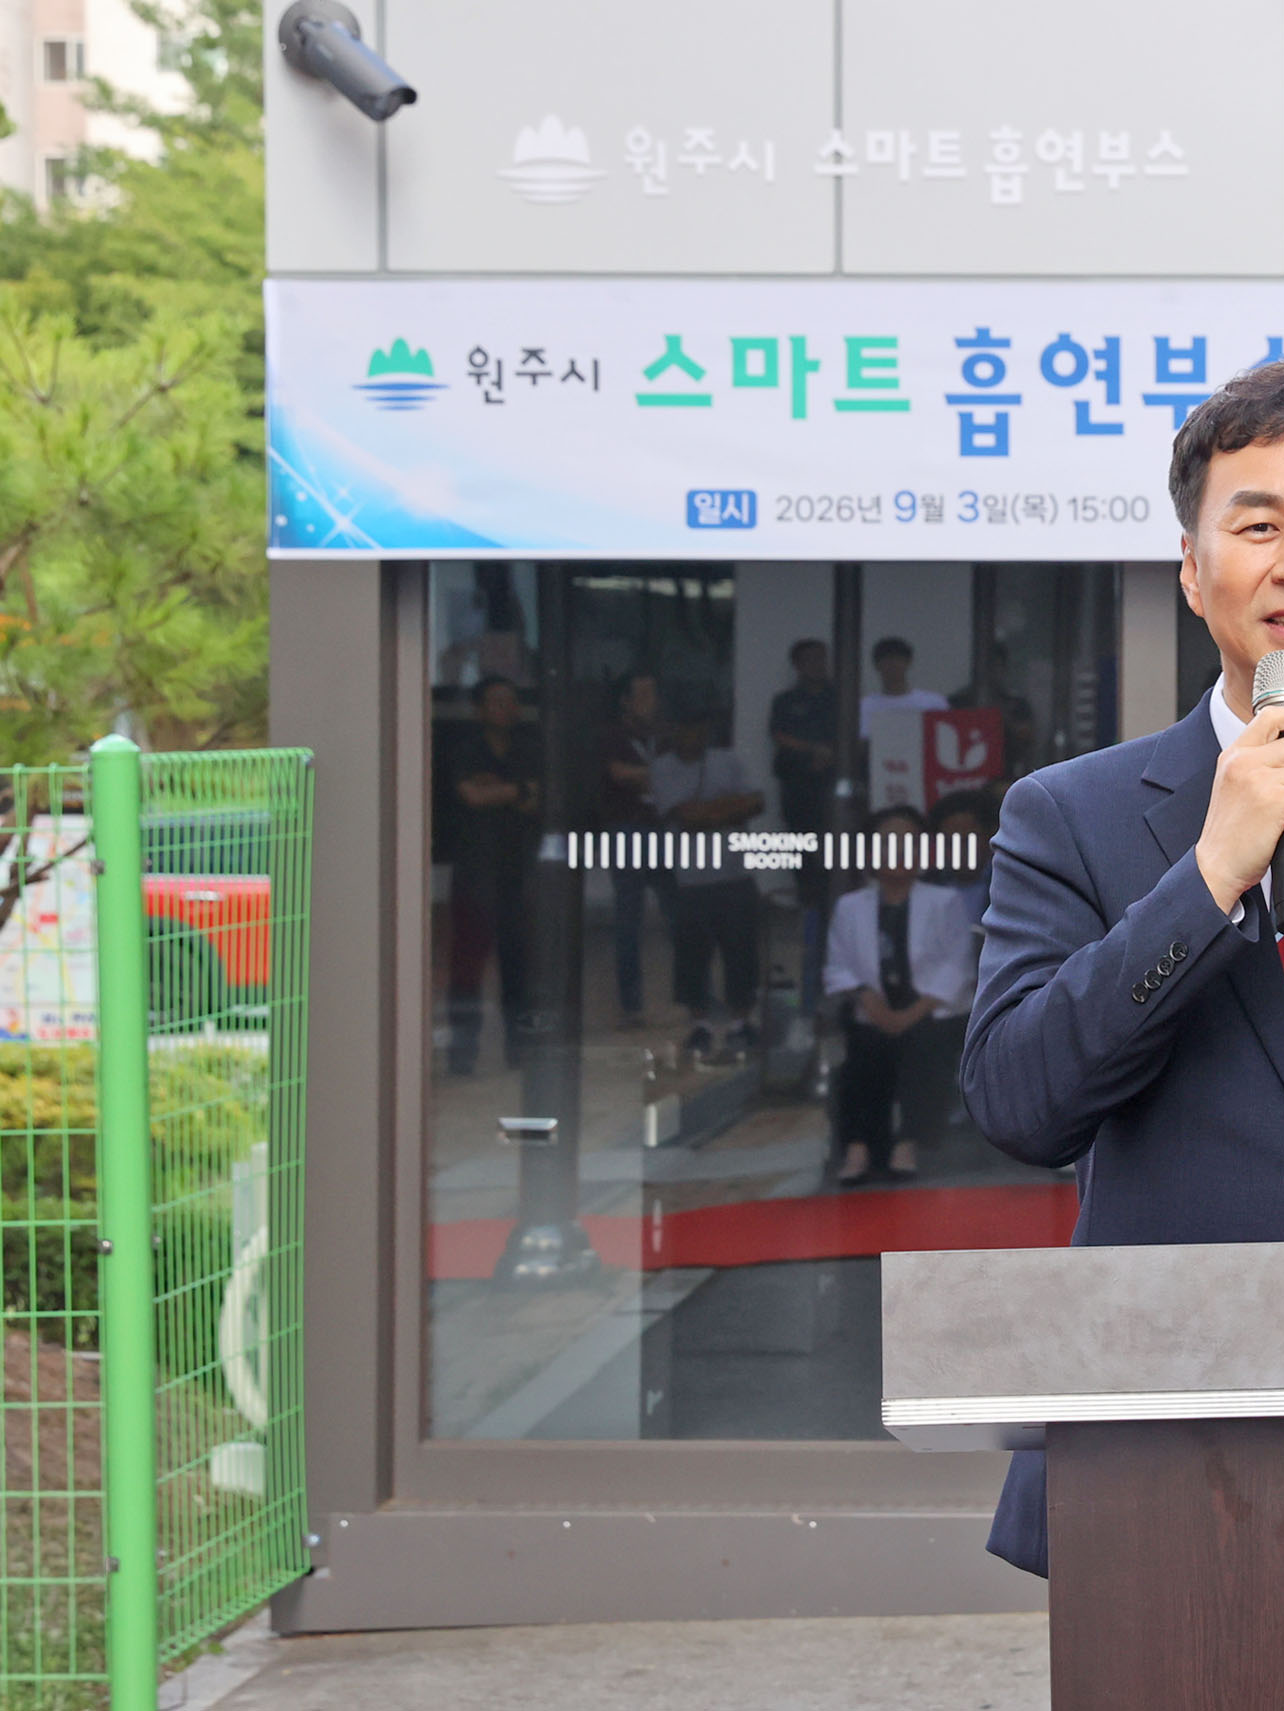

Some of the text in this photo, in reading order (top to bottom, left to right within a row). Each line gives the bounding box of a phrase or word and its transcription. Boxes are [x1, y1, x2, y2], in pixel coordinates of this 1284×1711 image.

[624, 126, 1190, 203] 원주시 스마트 흡연부스
[466, 345, 601, 405] 원주시
[634, 333, 911, 420] 스마트
[694, 492, 751, 525] 일시
[775, 489, 1150, 526] 2026년 9월 3일(목) 15:00
[727, 832, 819, 853] SMOKING
[743, 852, 803, 870] BOOTH
